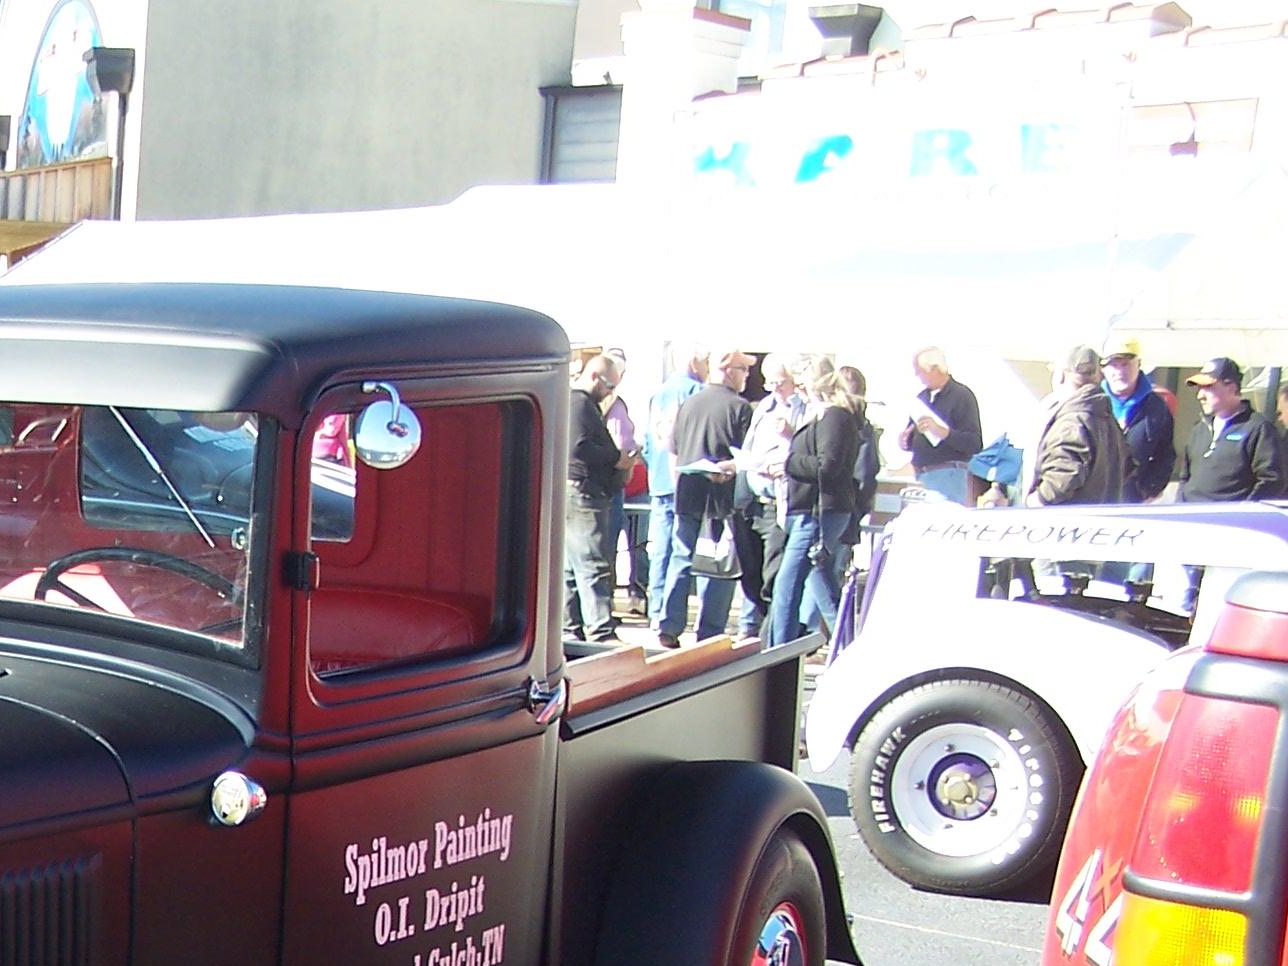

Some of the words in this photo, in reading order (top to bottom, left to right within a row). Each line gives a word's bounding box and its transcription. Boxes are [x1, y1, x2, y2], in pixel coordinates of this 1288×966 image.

[870, 726, 907, 833] FIREHAWK
[343, 836, 429, 905] Spilmor
[433, 807, 513, 869] Painting
[374, 896, 415, 945] O.I.
[424, 875, 485, 932] Dripit
